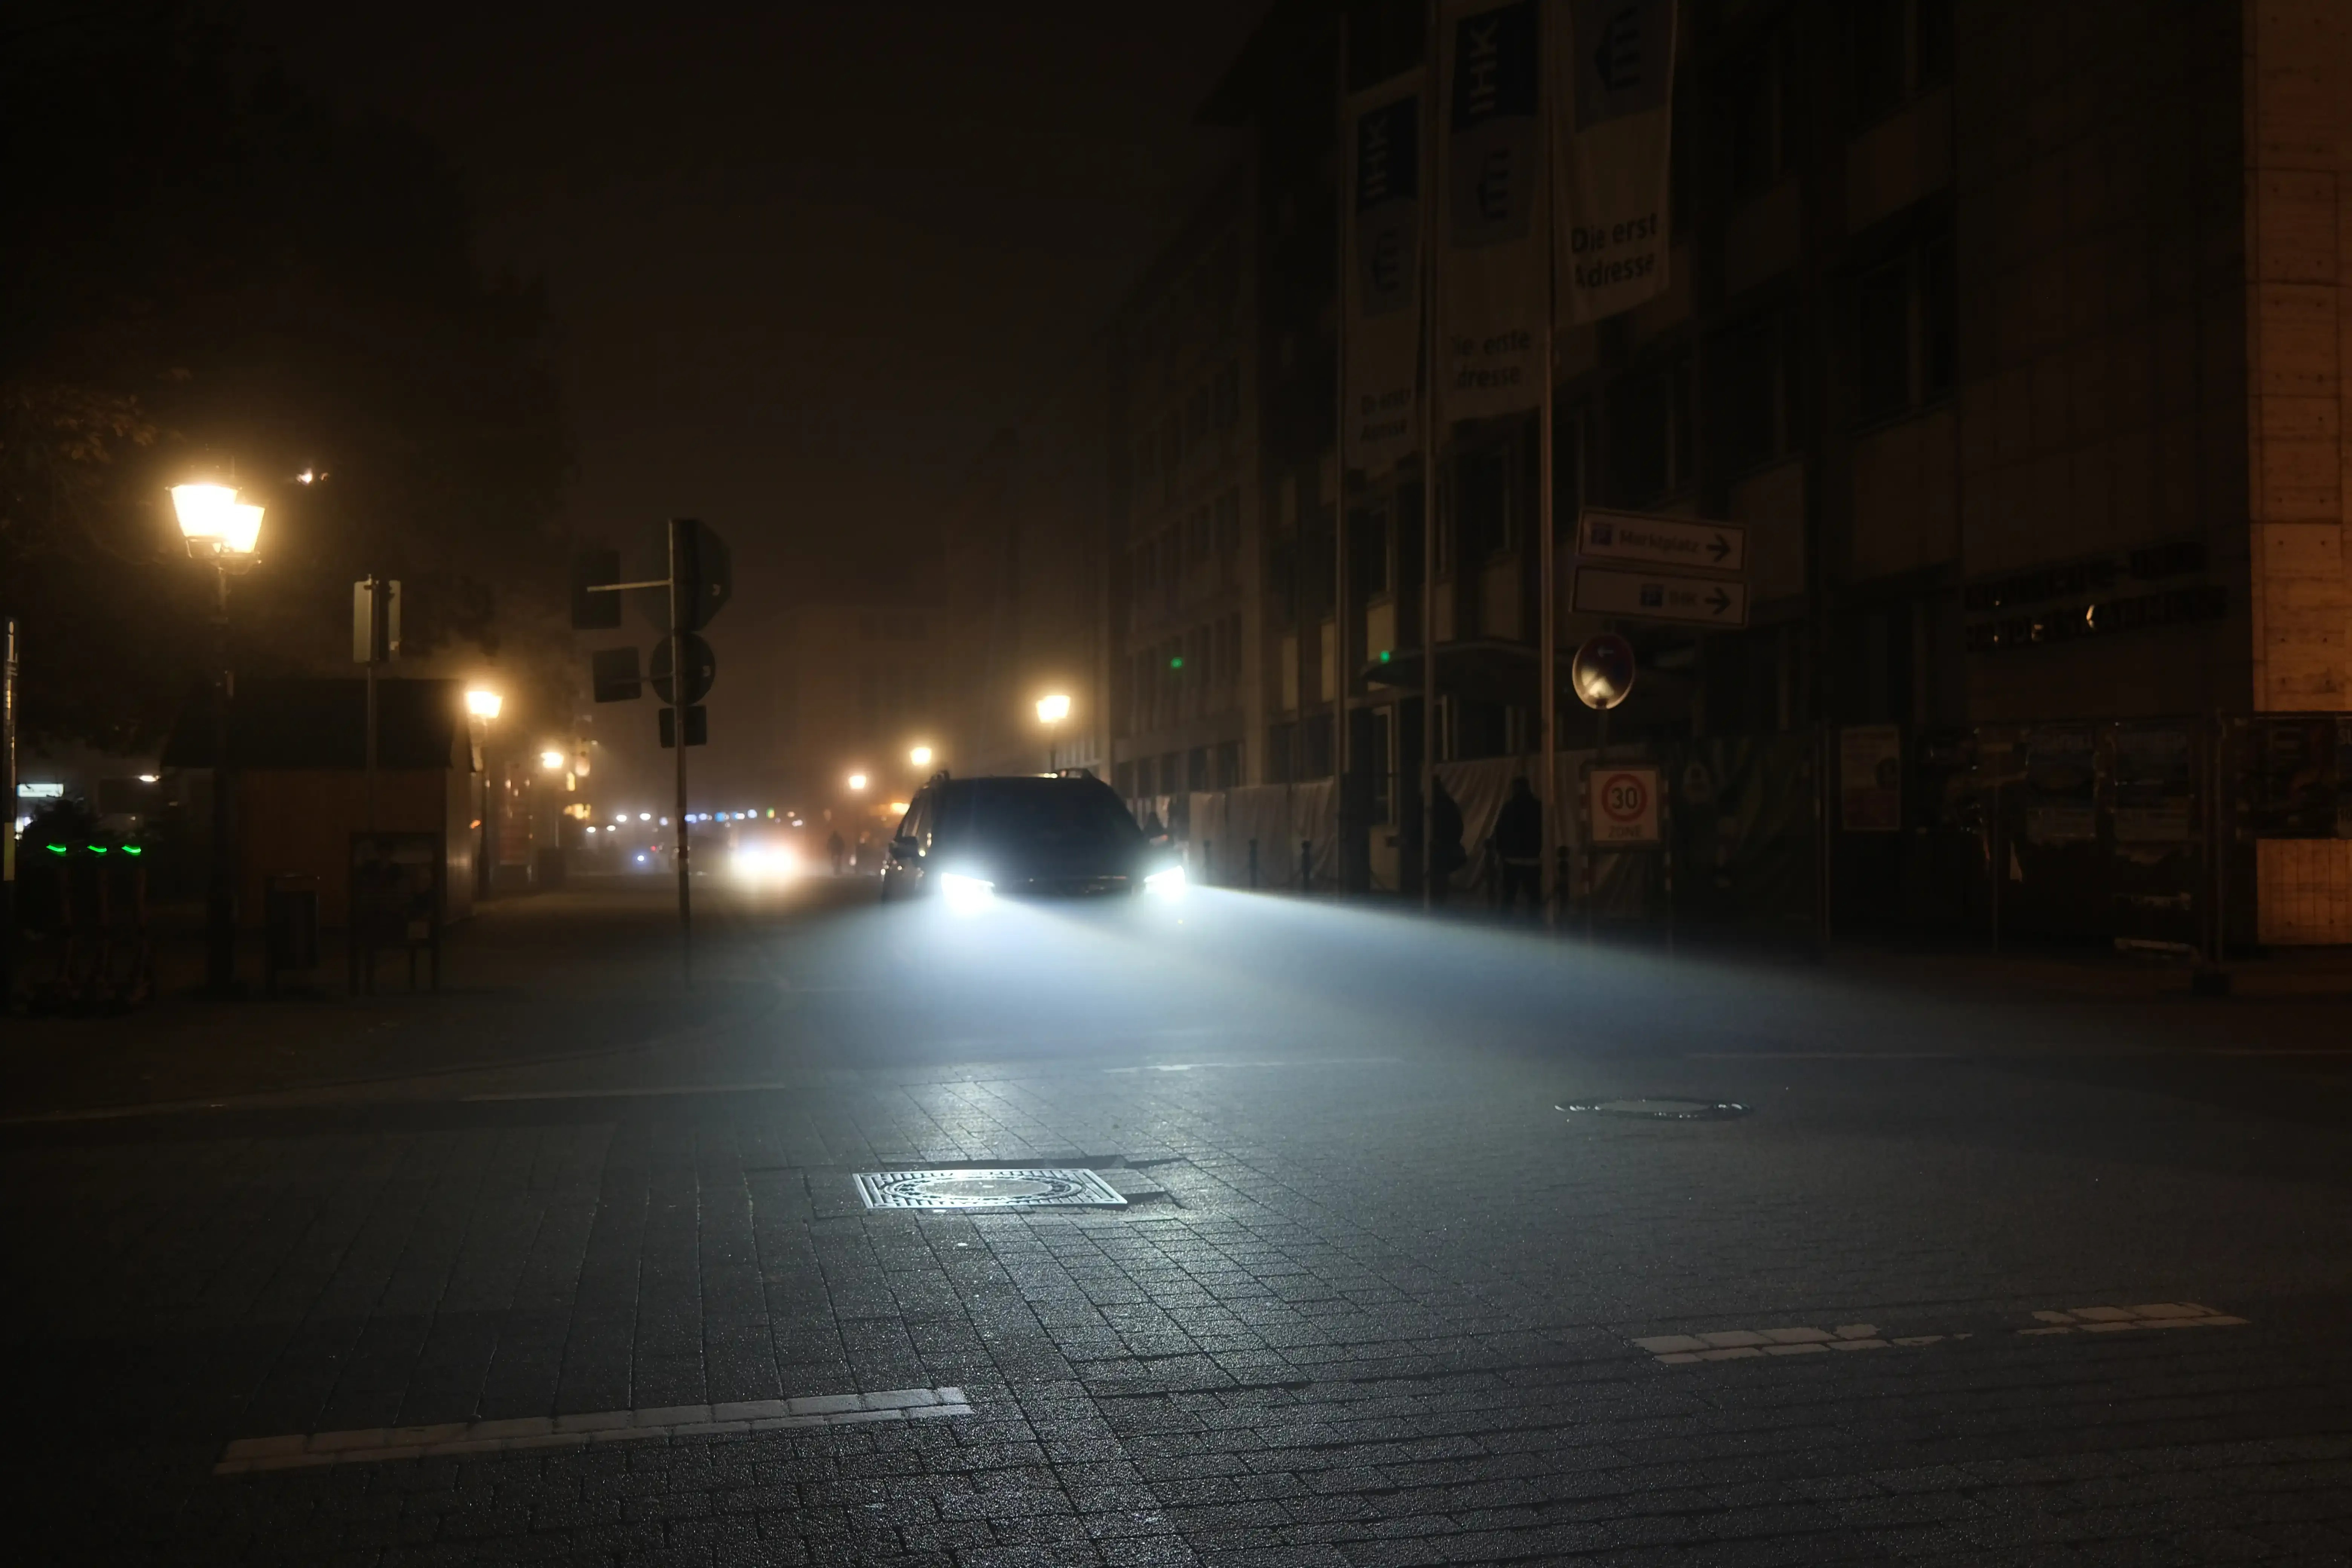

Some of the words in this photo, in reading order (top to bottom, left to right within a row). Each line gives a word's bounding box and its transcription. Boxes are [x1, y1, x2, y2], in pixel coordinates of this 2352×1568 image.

[1469, 17, 1499, 115] IHK
[1364, 116, 1388, 197] IHK
[1572, 225, 1605, 253] Die
[1454, 365, 1521, 389] dresse
[1611, 787, 1638, 809] 30
[1608, 824, 1642, 838] ZONE
